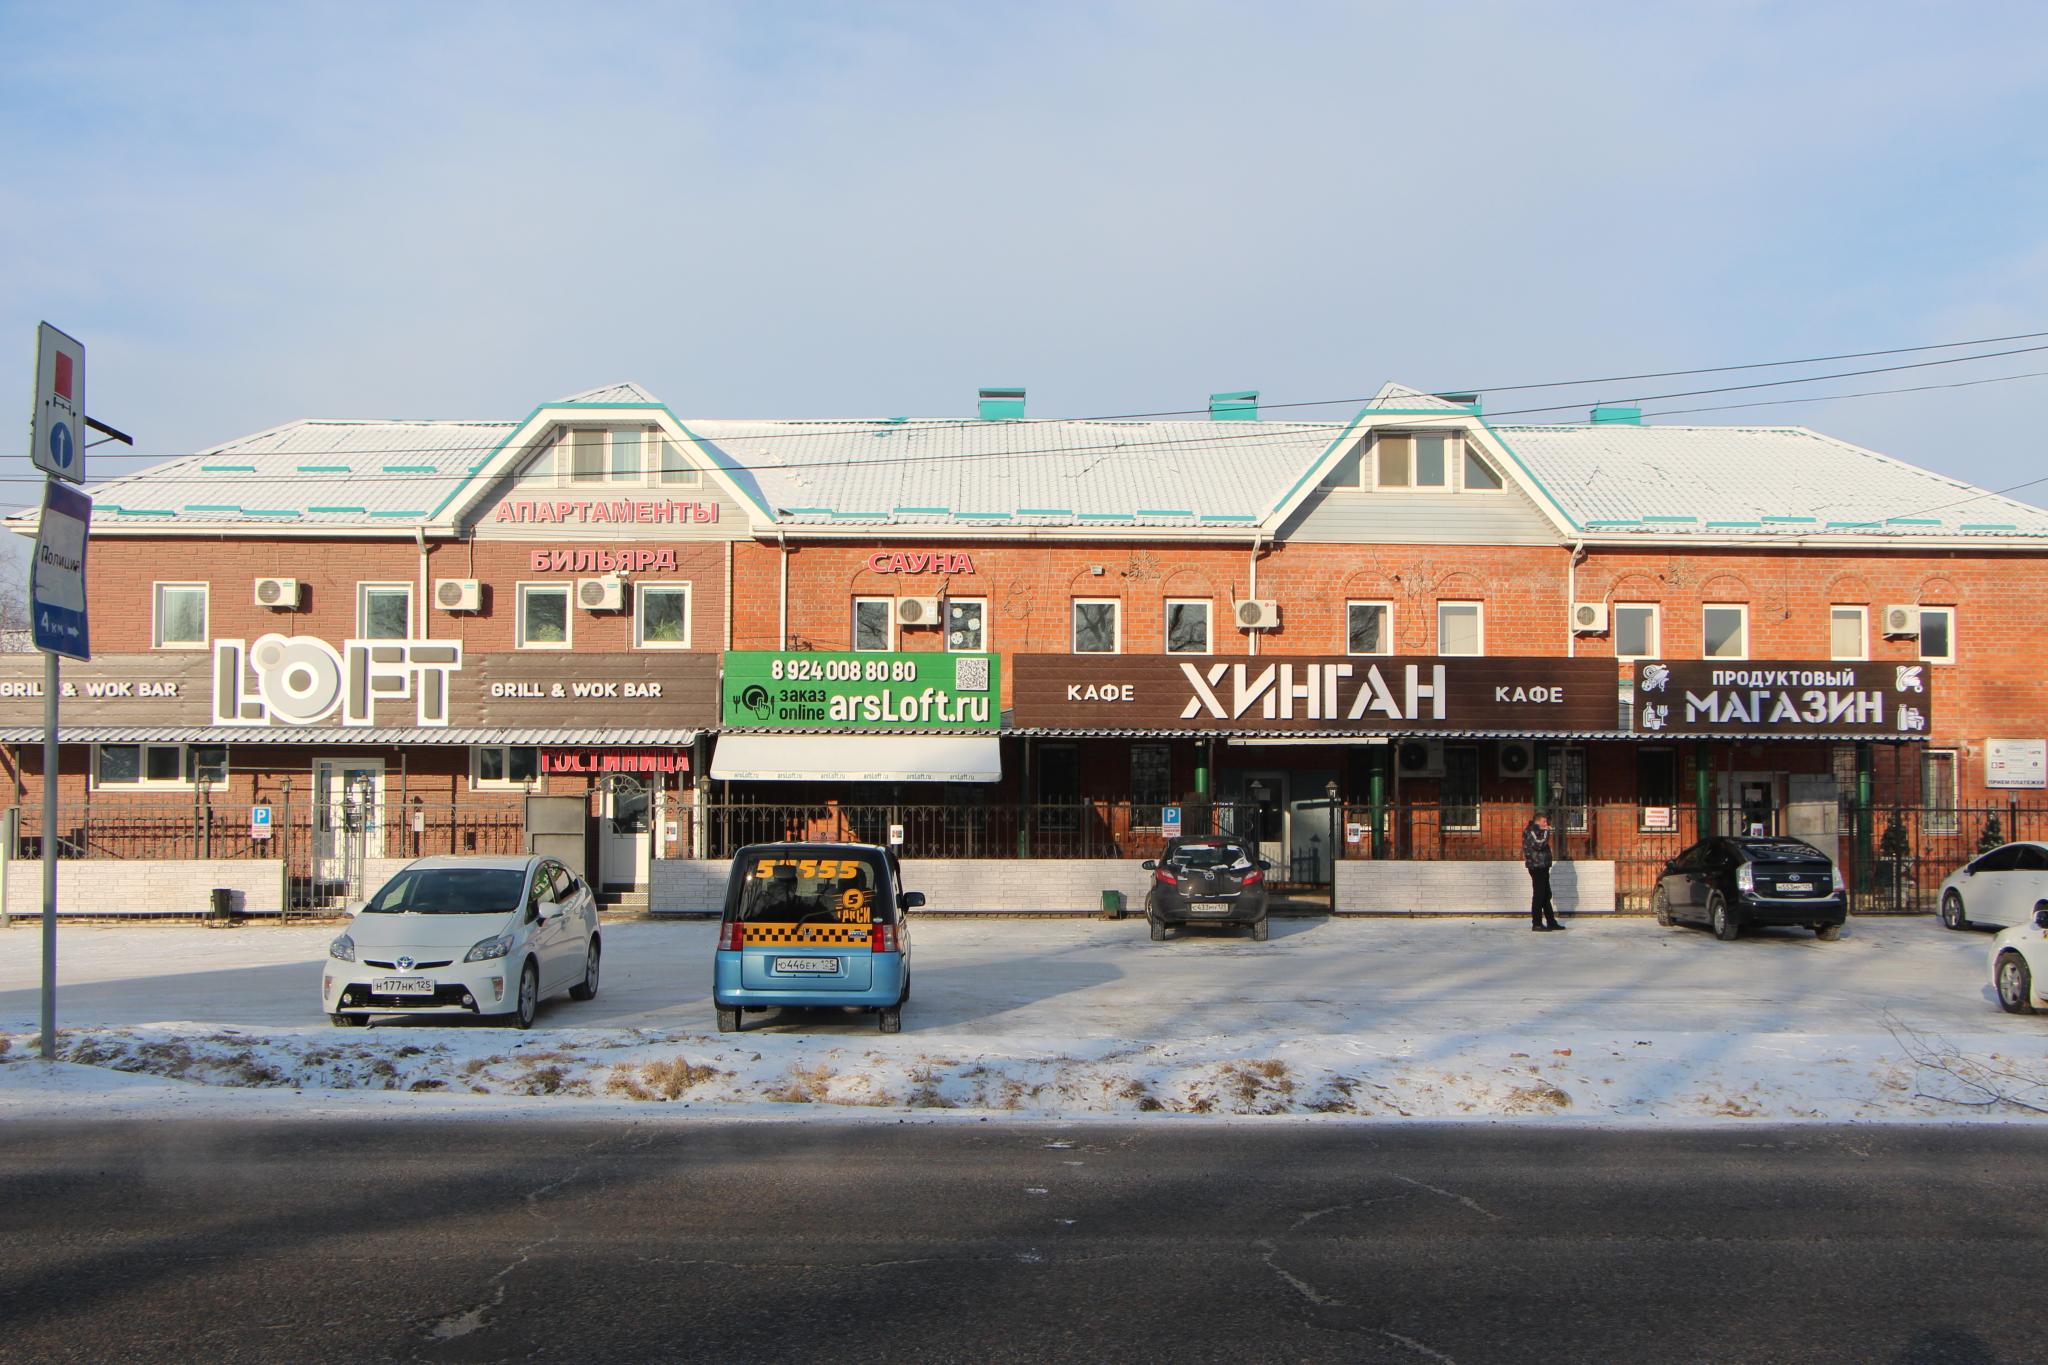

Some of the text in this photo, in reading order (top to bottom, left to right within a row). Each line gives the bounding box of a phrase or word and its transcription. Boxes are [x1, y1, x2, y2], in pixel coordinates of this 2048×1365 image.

[495, 501, 718, 522] АПАРТАМЕНТЫ
[41, 545, 81, 573] Полиция
[531, 549, 677, 571] БИЛЬЯРД
[868, 552, 974, 573] САУНА
[41, 611, 64, 636] 4 км
[213, 633, 462, 726] LOFT
[772, 660, 916, 682] 8 924 008 80 80
[1712, 668, 1854, 687] ПРОДУКТОВЫЙ
[0, 682, 178, 697] GRIL & WOK BAR
[491, 683, 662, 697] GRILL & WOK BAR
[779, 690, 826, 702] заказ
[1067, 683, 1134, 702] КАФЕ
[1180, 663, 1446, 720] ХИНГАН
[1495, 685, 1563, 703] КАФЕ
[779, 704, 825, 721] online
[829, 688, 989, 722] arsLoft.ru
[1685, 690, 1883, 723] МАГАЗИН
[541, 748, 690, 774] ГОСТИНИЦА
[257, 810, 266, 823] P
[1167, 809, 1176, 822] P
[847, 894, 859, 905] 5
[376, 981, 431, 991] Н177НК 125
